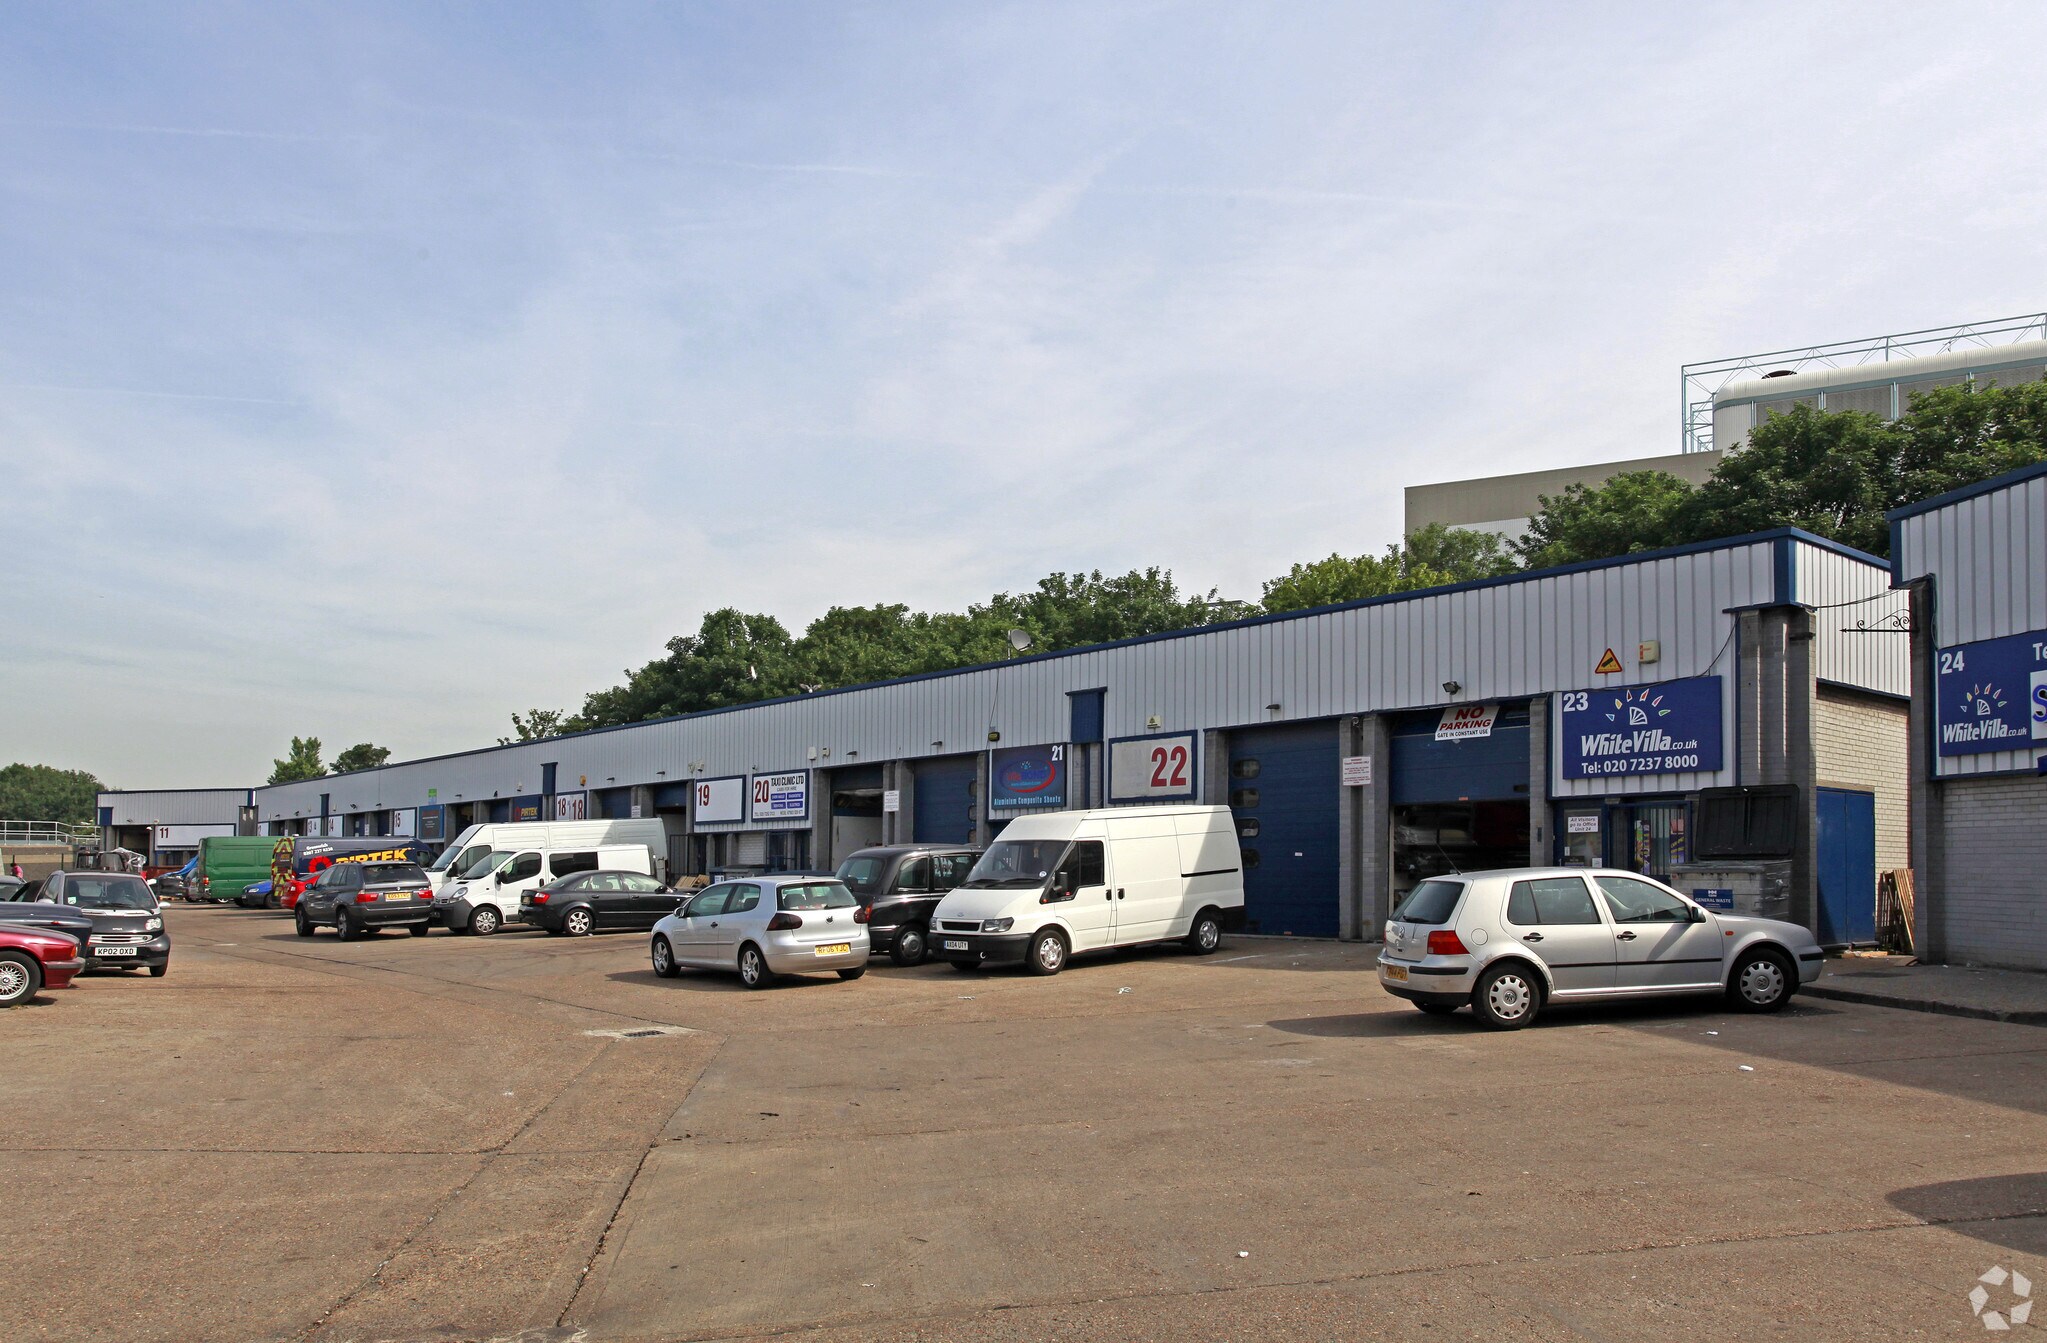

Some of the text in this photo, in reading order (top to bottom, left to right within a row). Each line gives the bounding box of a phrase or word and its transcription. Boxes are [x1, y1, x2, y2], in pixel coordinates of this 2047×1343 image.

[1940, 650, 1964, 674] 24
[1563, 692, 1588, 712] 23
[1455, 706, 1484, 720] NO
[1440, 718, 1491, 731] PARKING
[1052, 745, 1063, 761] 21
[1151, 745, 1187, 787] 22
[1582, 754, 1698, 774] Tel: 020 7237 8000
[771, 775, 804, 787] TAXI CLINIC LTD
[698, 784, 710, 806] 19
[754, 780, 769, 803] 20
[1018, 797, 1042, 805] Composite
[558, 798, 566, 816] 18
[572, 800, 584, 820] 18
[160, 828, 168, 838] 11
